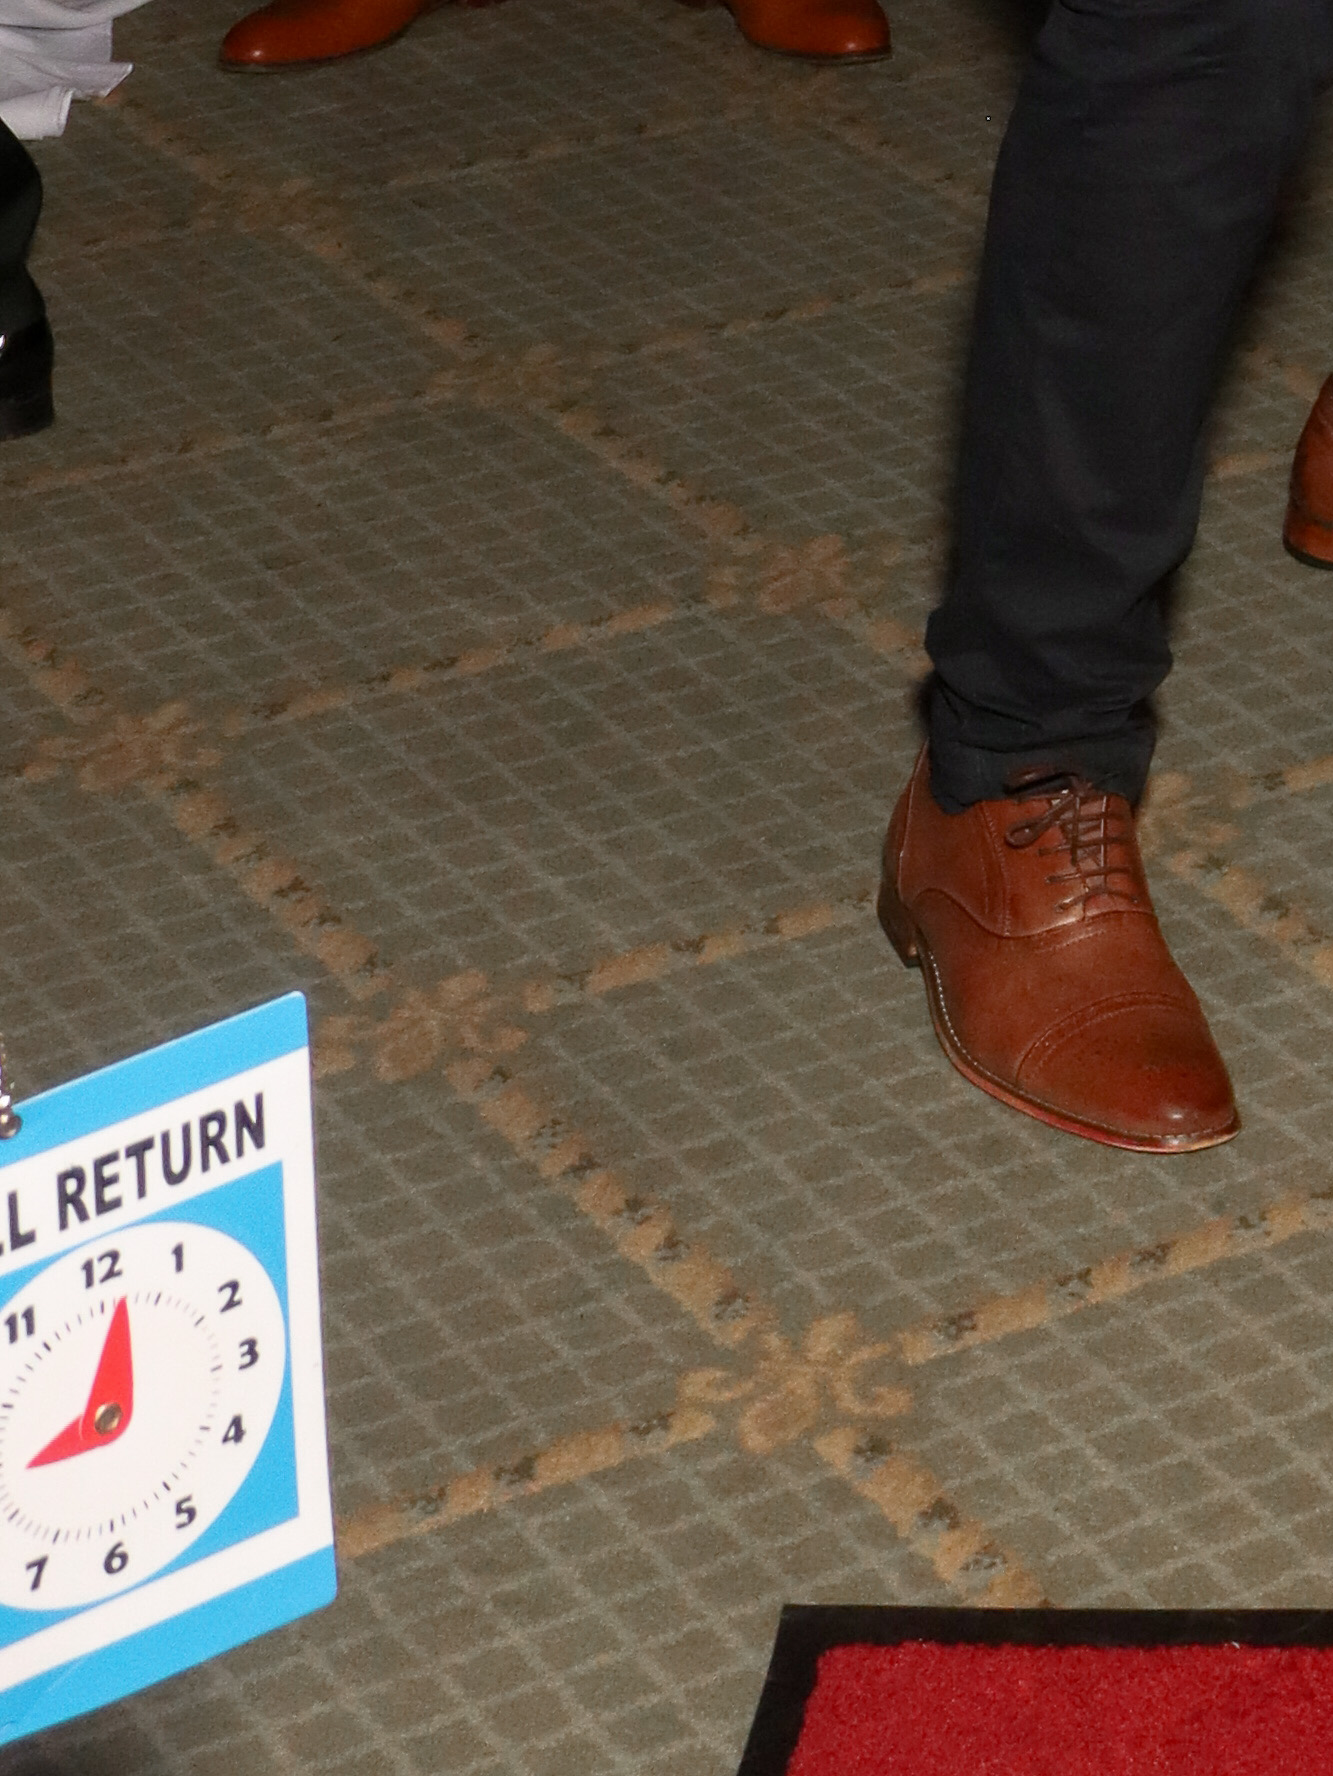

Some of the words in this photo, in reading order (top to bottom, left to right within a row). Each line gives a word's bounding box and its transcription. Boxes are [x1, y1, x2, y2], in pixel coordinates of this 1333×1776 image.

[0, 1189, 37, 1257] L
[56, 1092, 266, 1233] RETURN
[81, 1249, 123, 1289] 12
[171, 1242, 184, 1274] 1
[218, 1279, 243, 1314] 2
[4, 1305, 36, 1345] 11
[239, 1337, 260, 1370] 3
[222, 1414, 246, 1446] 4
[174, 1496, 197, 1529] 5
[25, 1555, 49, 1591] 7
[103, 1541, 129, 1575] 6
